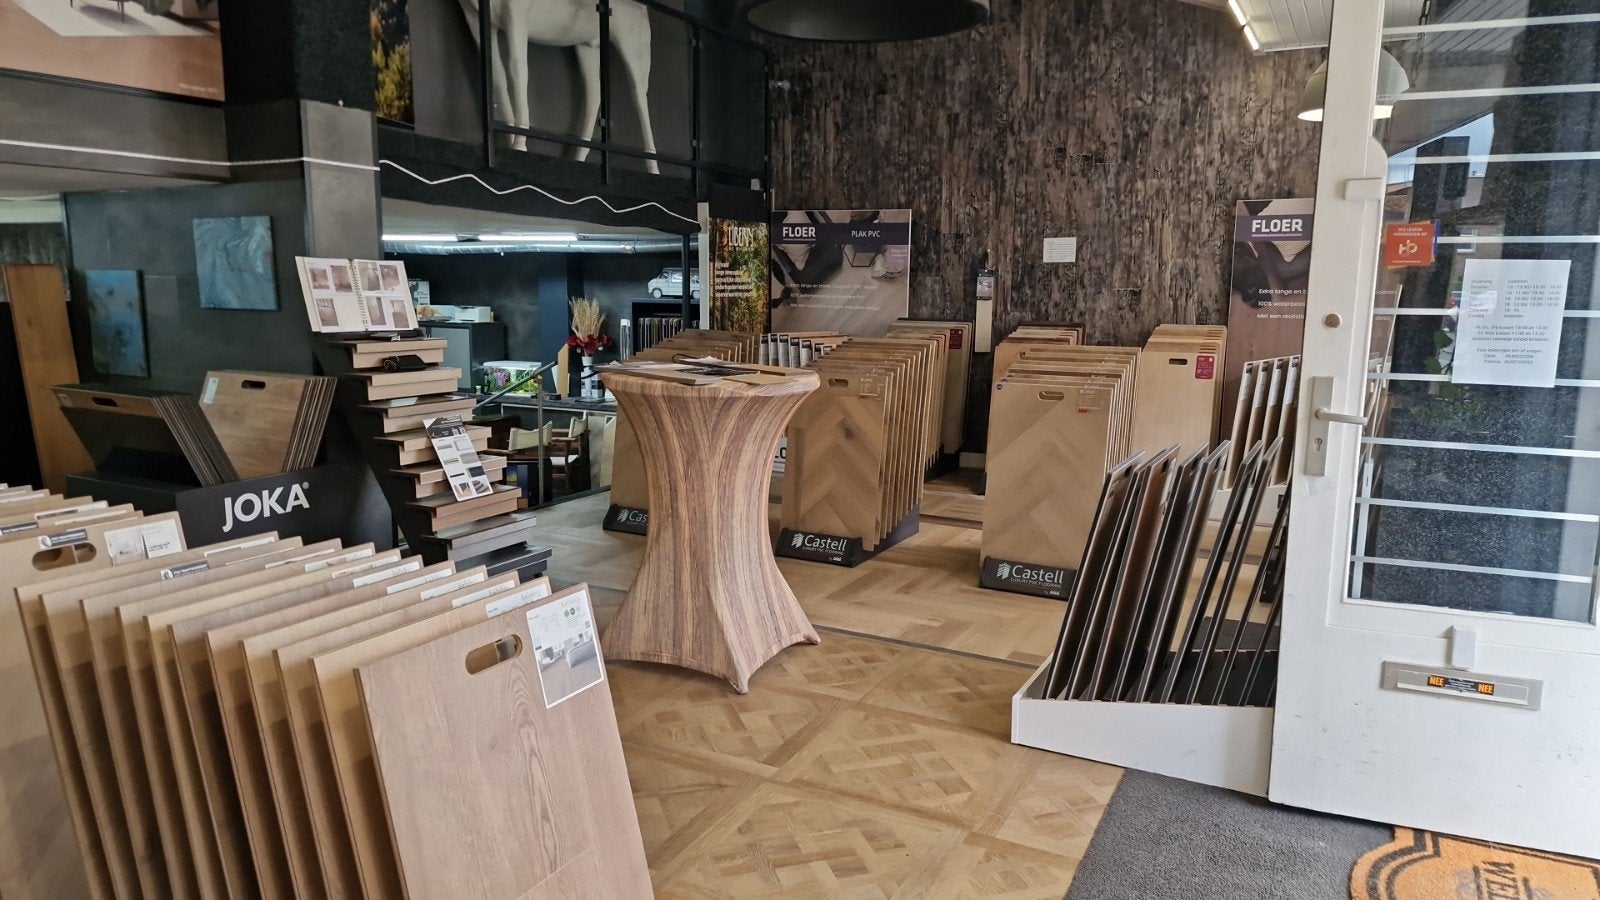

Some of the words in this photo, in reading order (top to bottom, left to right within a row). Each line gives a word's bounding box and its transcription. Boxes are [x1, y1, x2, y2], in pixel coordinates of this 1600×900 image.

[782, 226, 816, 238] FLOER
[1251, 218, 1303, 233] FLOER
[851, 230, 867, 238] PLAK
[867, 230, 881, 238] PVC
[1274, 287, 1293, 297] lange
[804, 534, 848, 551] Castell
[1012, 564, 1064, 584] Castell
[1429, 675, 1445, 686] NEE
[1477, 683, 1493, 694] NEE
